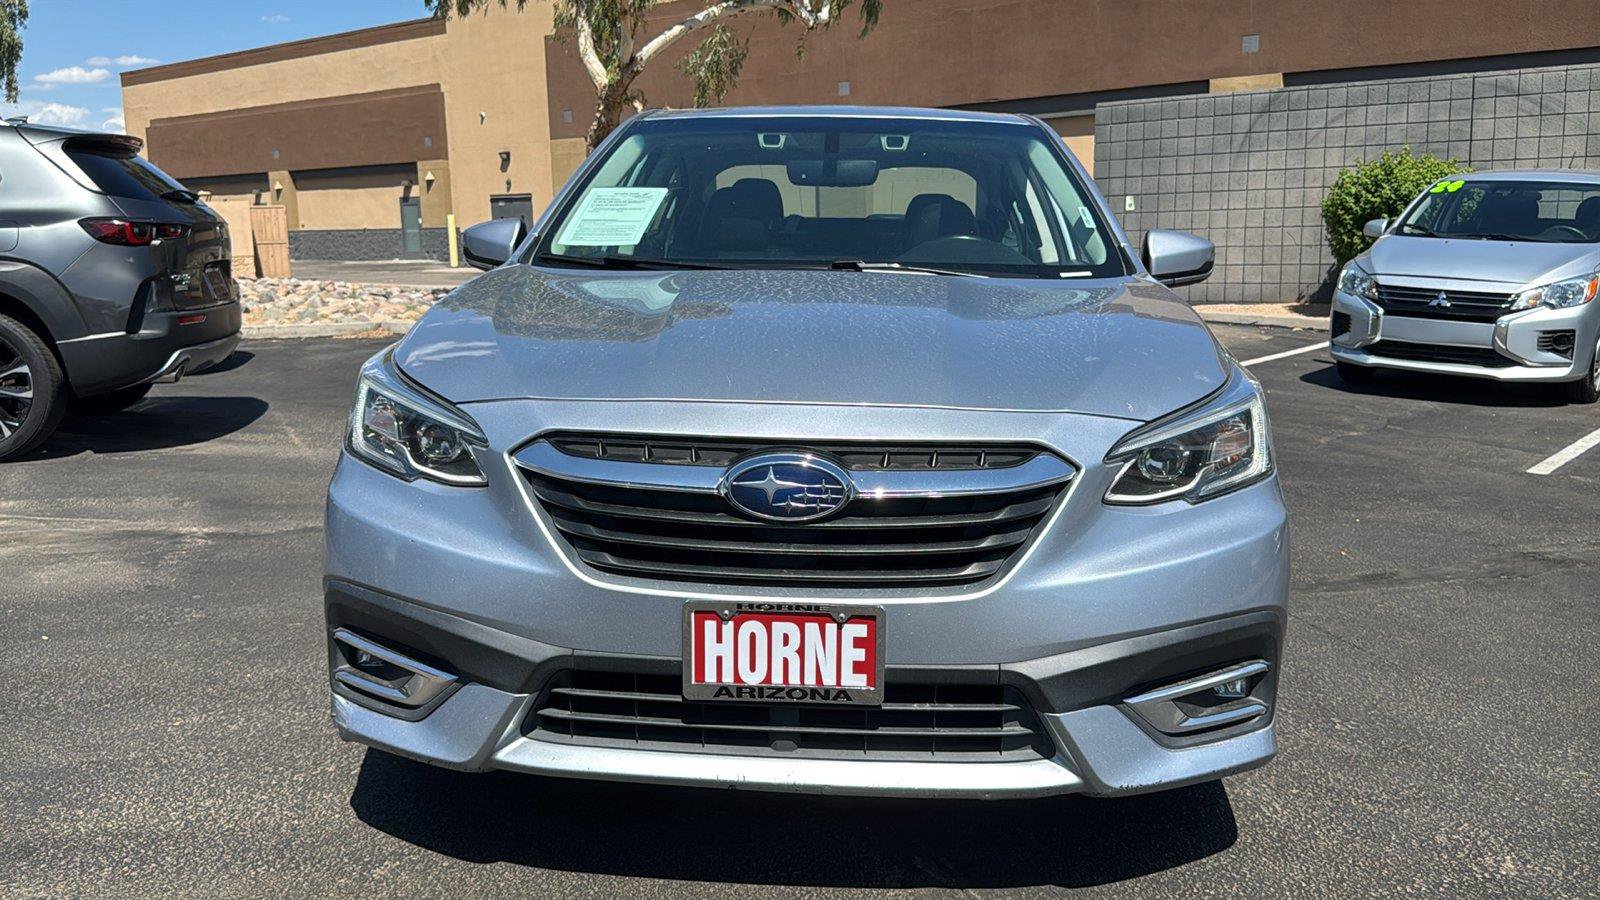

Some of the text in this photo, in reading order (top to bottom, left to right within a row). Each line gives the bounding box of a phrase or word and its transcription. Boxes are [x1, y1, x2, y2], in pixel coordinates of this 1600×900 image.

[736, 603, 830, 611] HORNE
[704, 619, 868, 687] HORNE
[713, 687, 853, 702] ARIZONA
